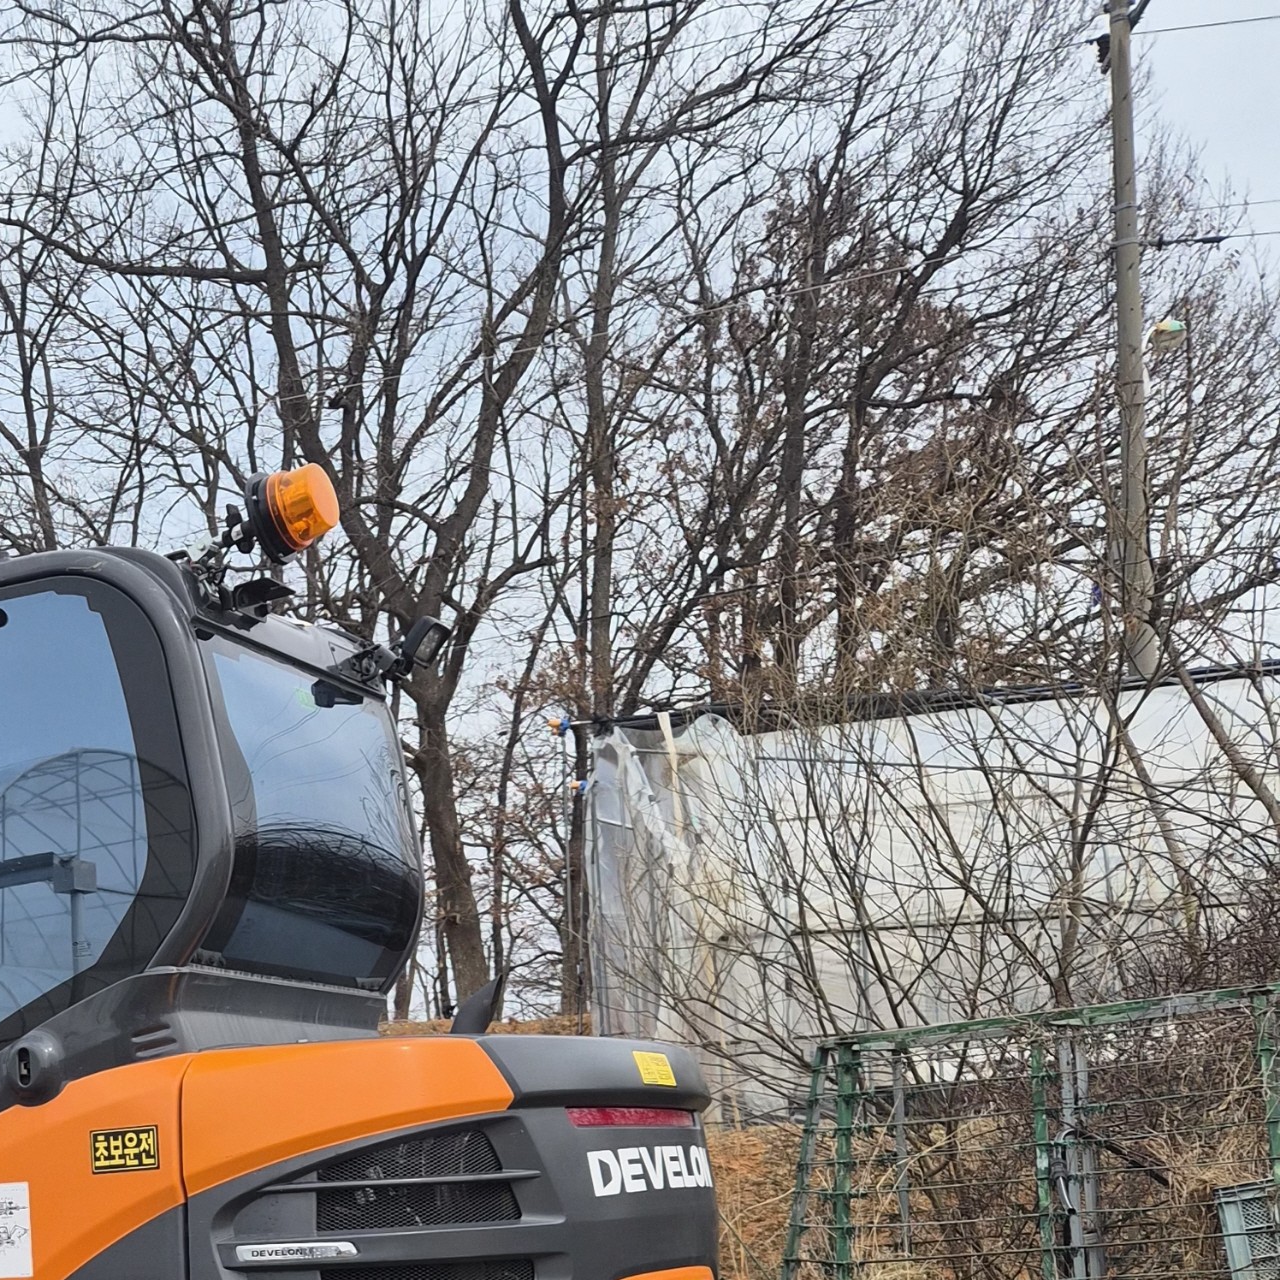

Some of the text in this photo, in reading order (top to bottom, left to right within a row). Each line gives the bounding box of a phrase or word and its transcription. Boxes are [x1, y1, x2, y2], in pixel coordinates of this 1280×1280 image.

[95, 1130, 156, 1167] 초보운전
[586, 1145, 714, 1197] DEVELON
[251, 1248, 303, 1258] DEVELON
